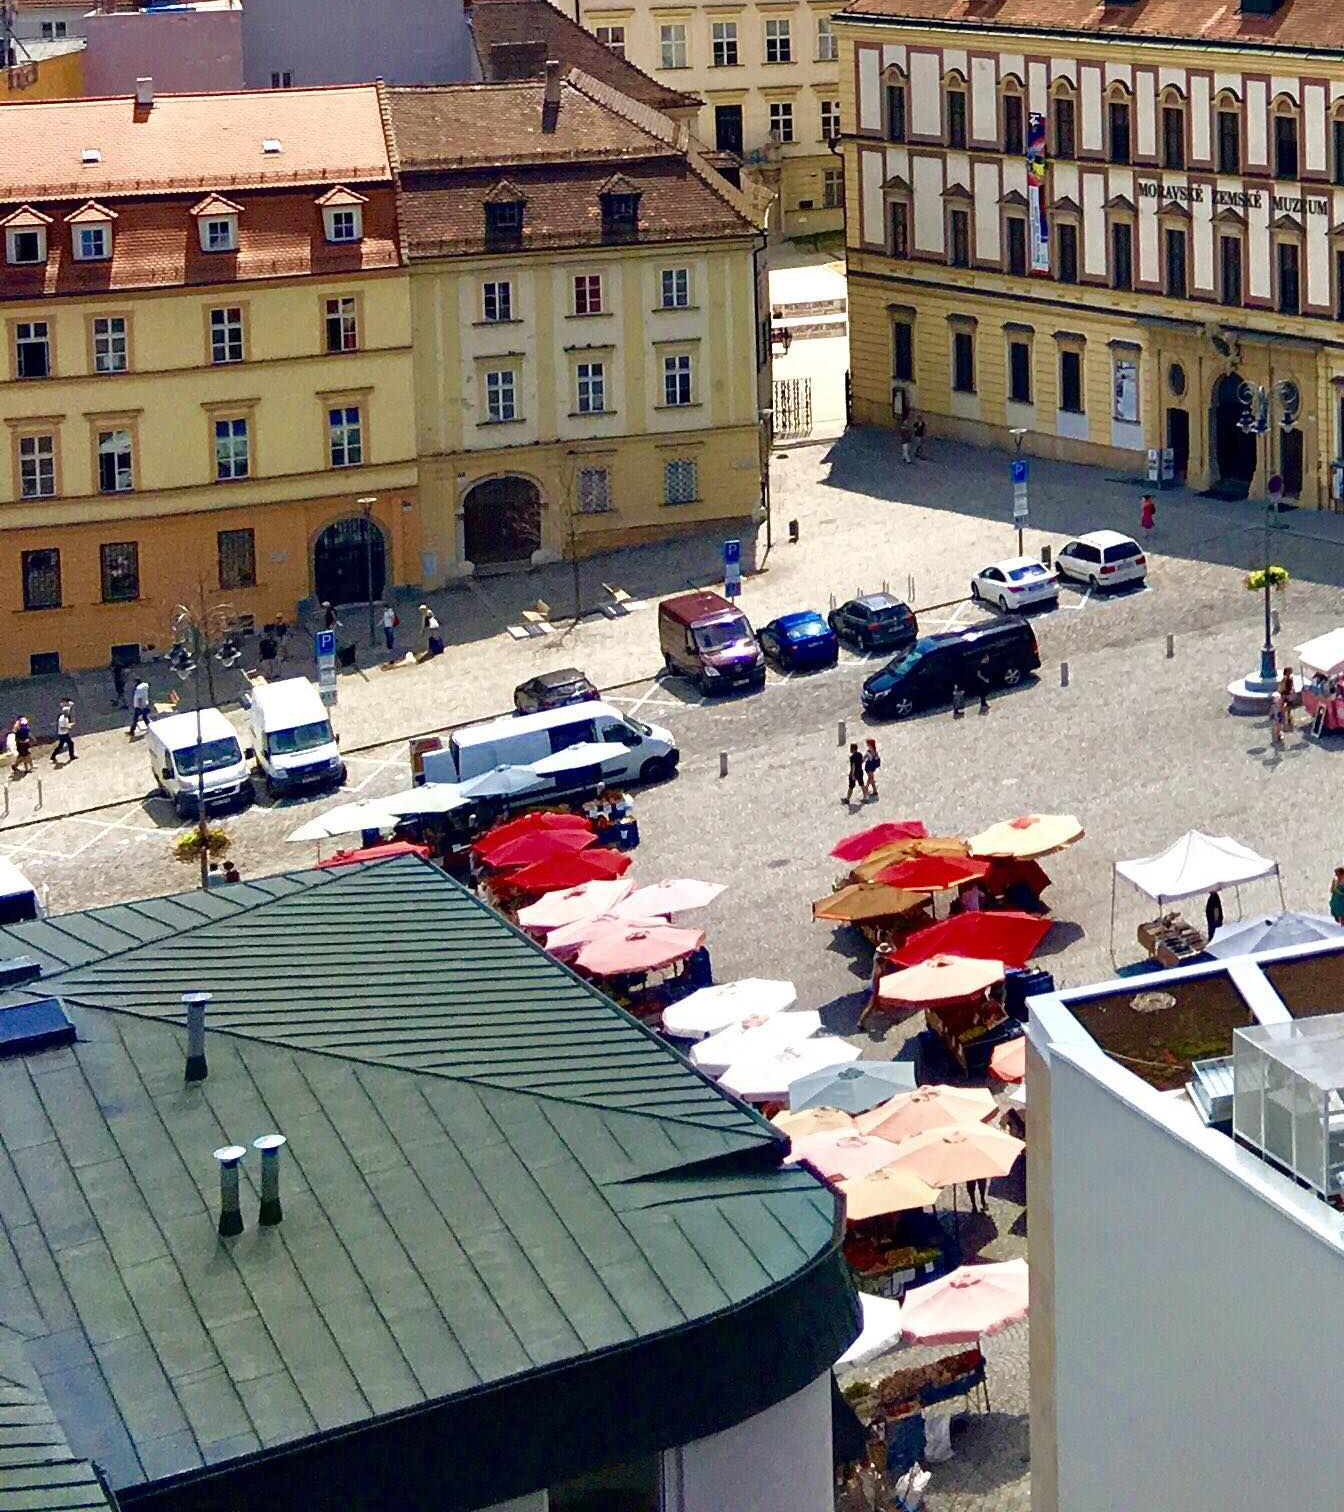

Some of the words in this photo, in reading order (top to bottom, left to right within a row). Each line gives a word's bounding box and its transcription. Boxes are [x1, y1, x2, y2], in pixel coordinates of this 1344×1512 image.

[1138, 182, 1204, 204] MORAVSKÉ
[1212, 190, 1263, 209] ZEMSKÉ
[1272, 195, 1328, 216] MUZEUM
